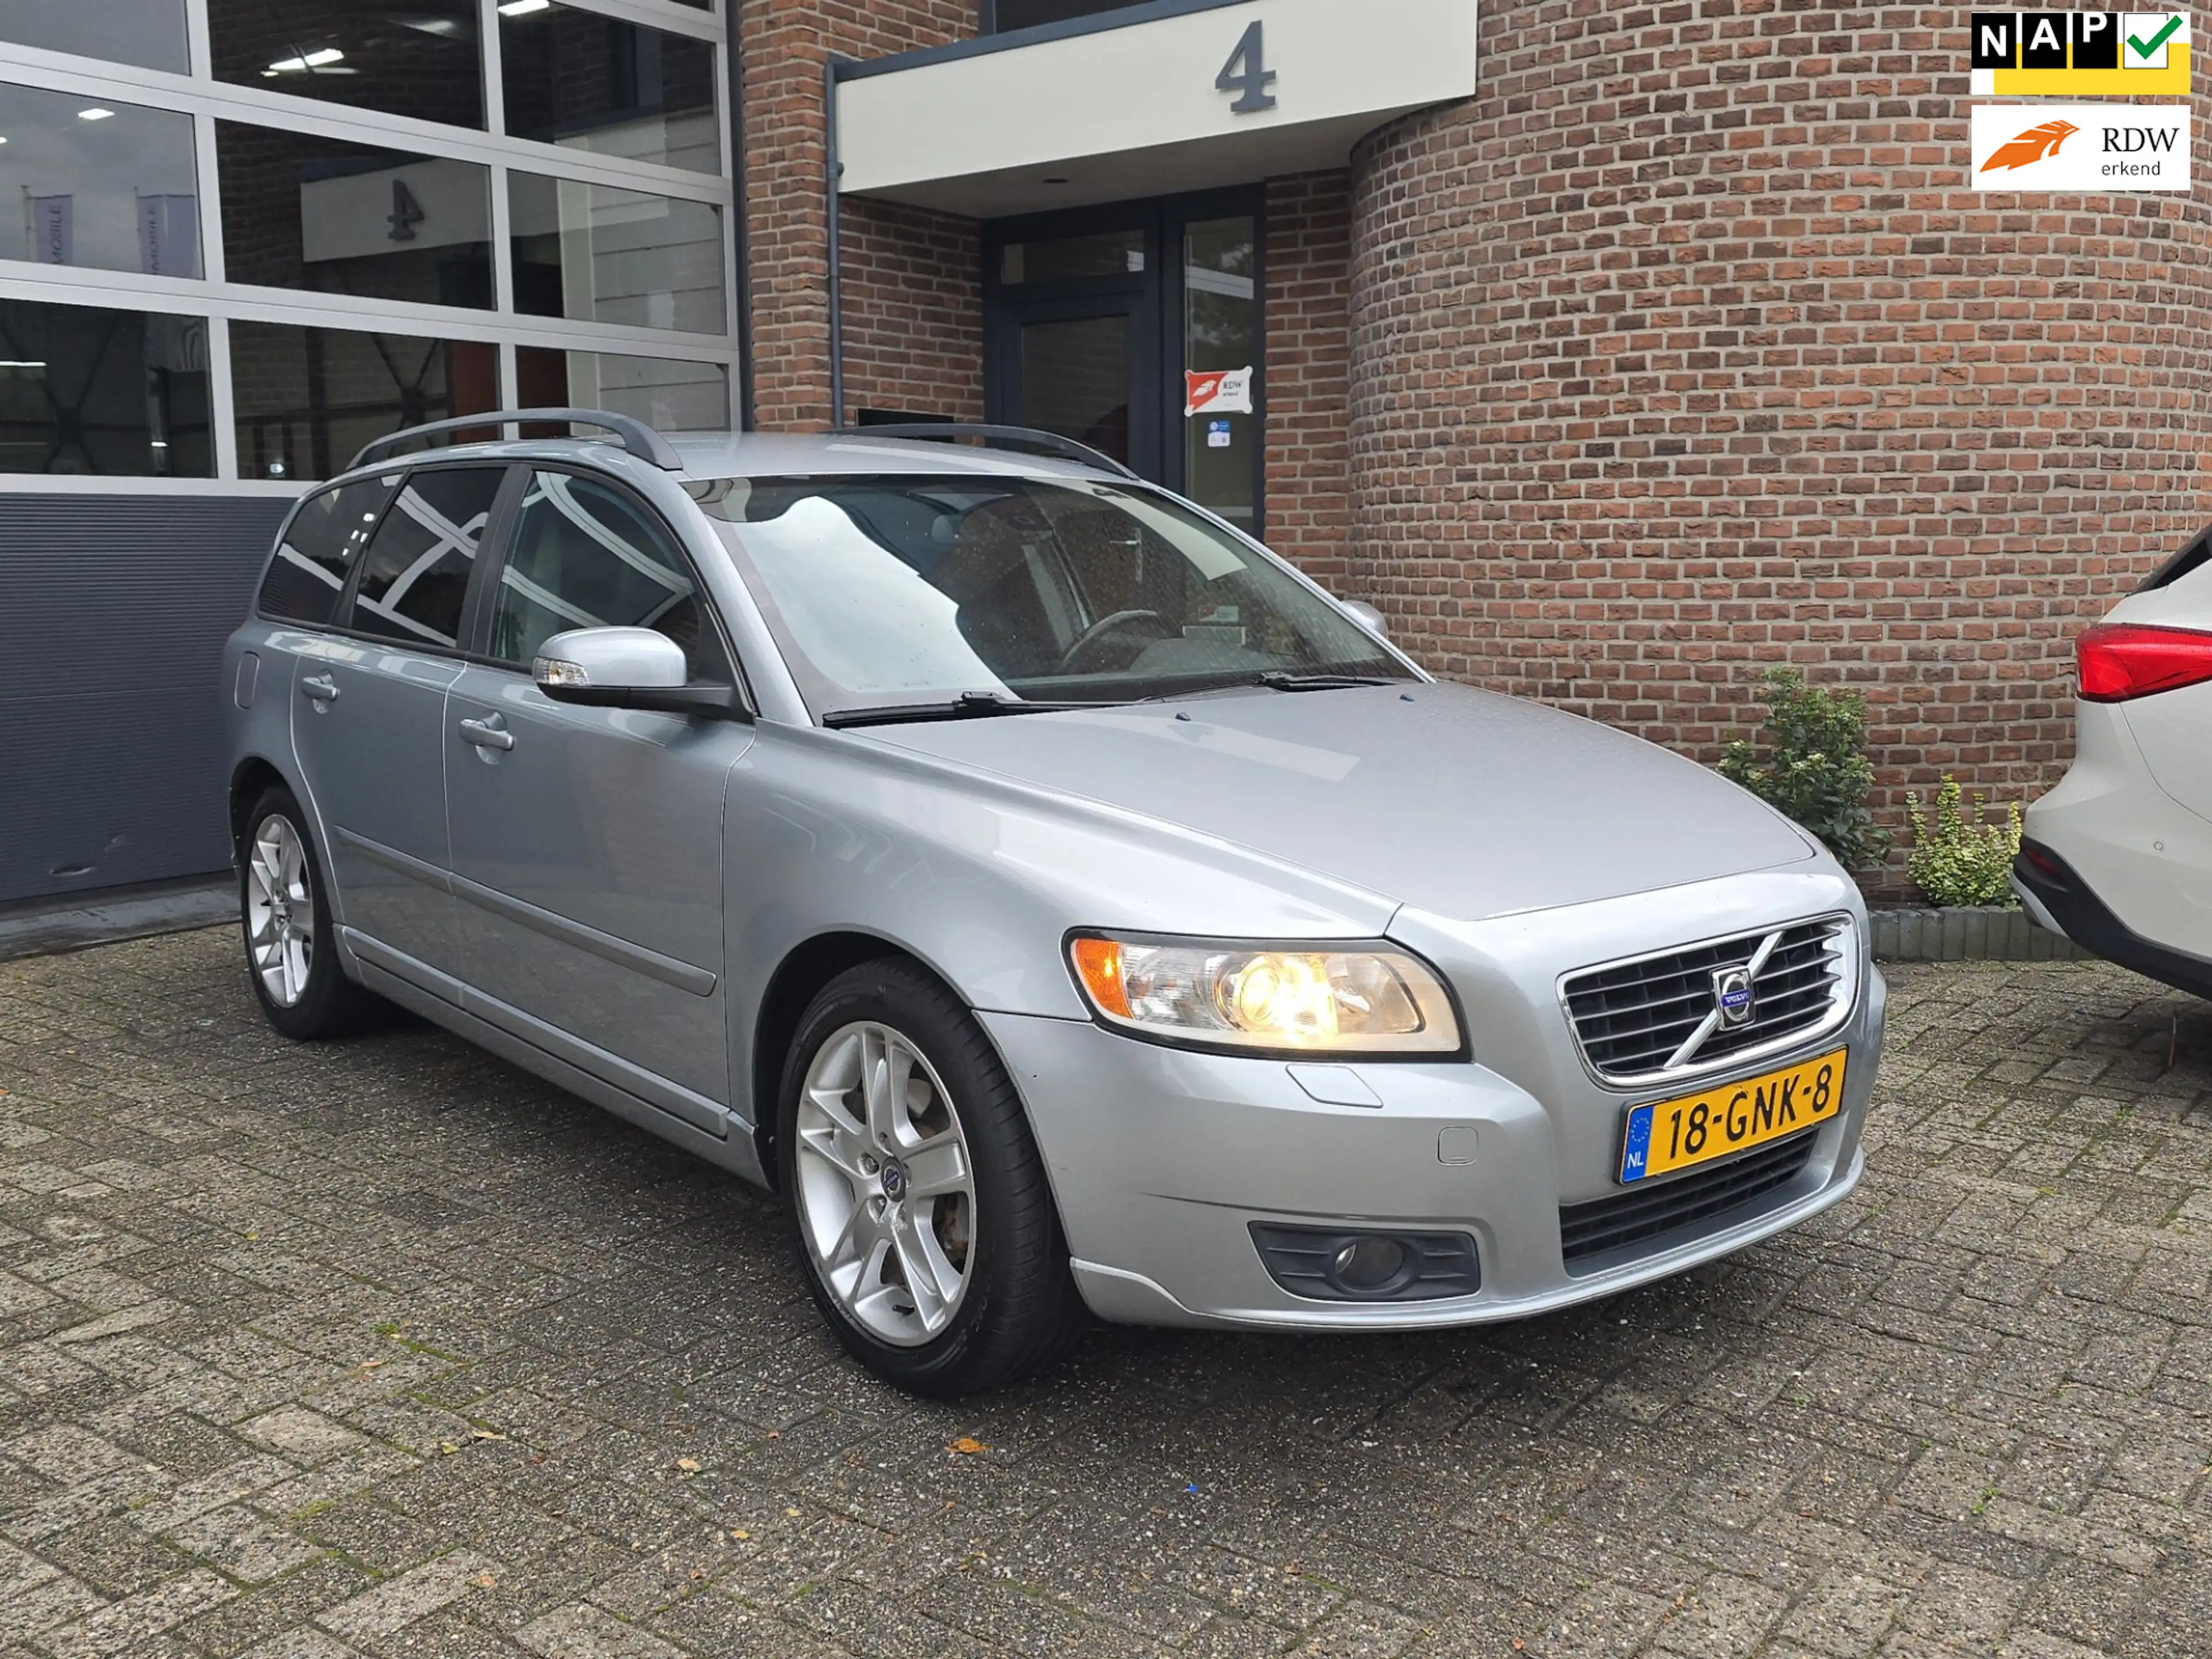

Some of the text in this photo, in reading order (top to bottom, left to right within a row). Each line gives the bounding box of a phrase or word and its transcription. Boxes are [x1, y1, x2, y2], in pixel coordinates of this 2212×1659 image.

[1215, 20, 1276, 112] 4
[1223, 381, 1243, 389] RDW
[1724, 993, 1749, 1003] VOLVO
[1670, 1063, 1832, 1160] 18-GNK-8
[1627, 1151, 1644, 1169] NL
